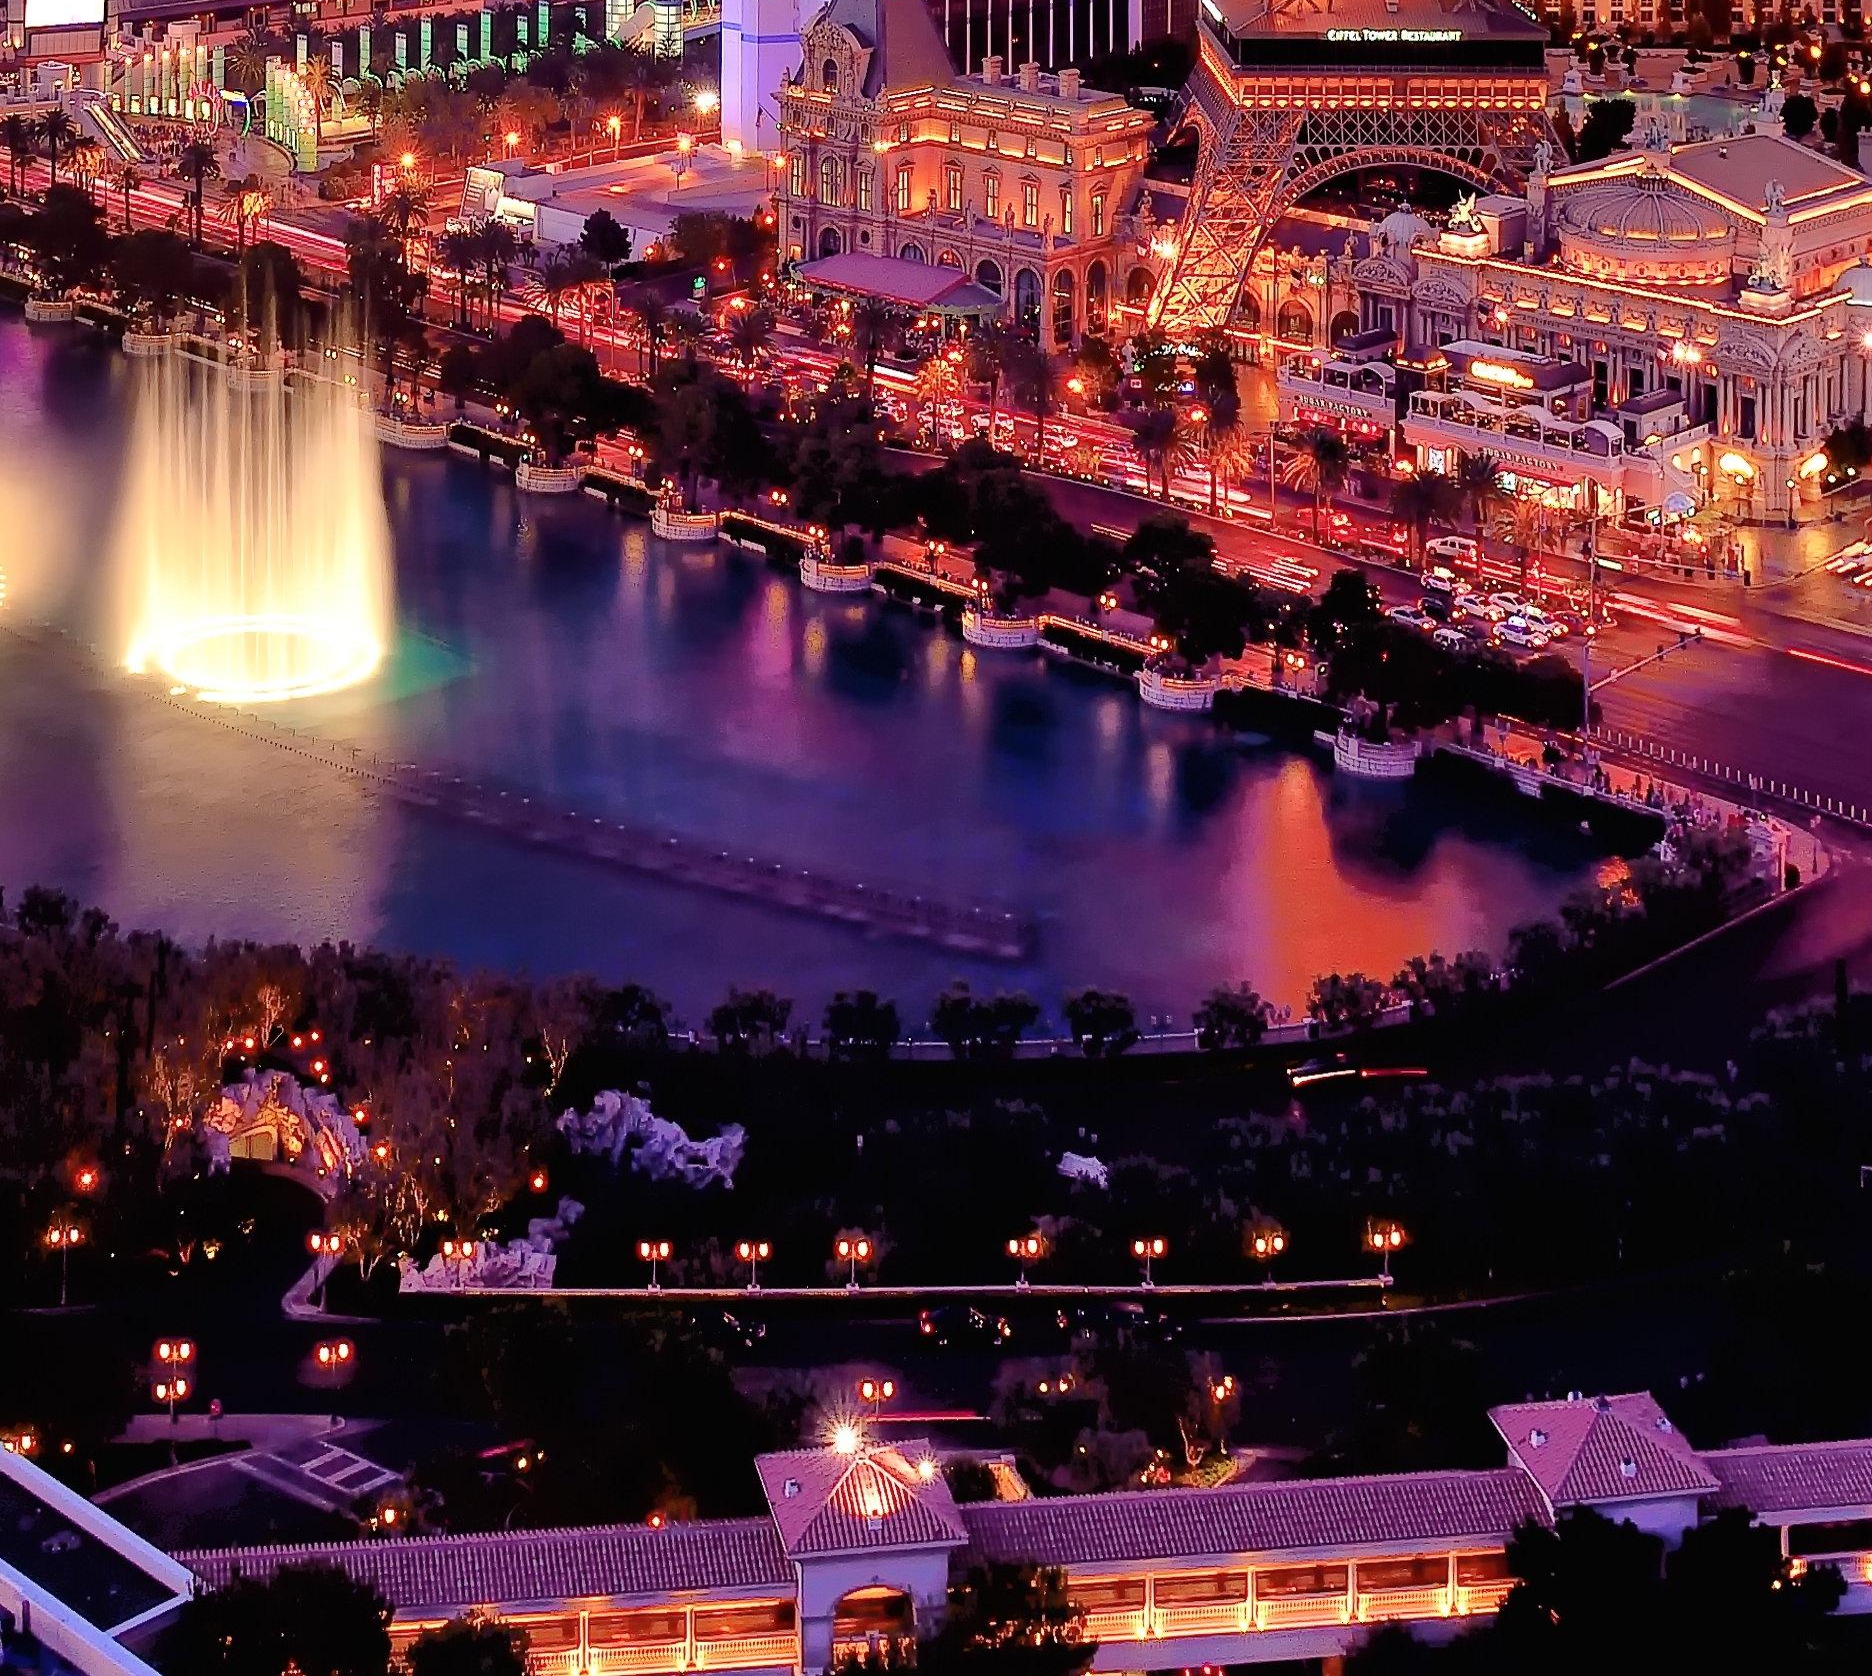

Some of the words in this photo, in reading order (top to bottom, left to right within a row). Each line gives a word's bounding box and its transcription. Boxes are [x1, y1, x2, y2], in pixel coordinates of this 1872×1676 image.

[1299, 395, 1325, 407] SUGAR
[1328, 402, 1368, 417] FACTORY
[1483, 447, 1512, 461] SUGAR
[1515, 454, 1558, 471] FACTORY
